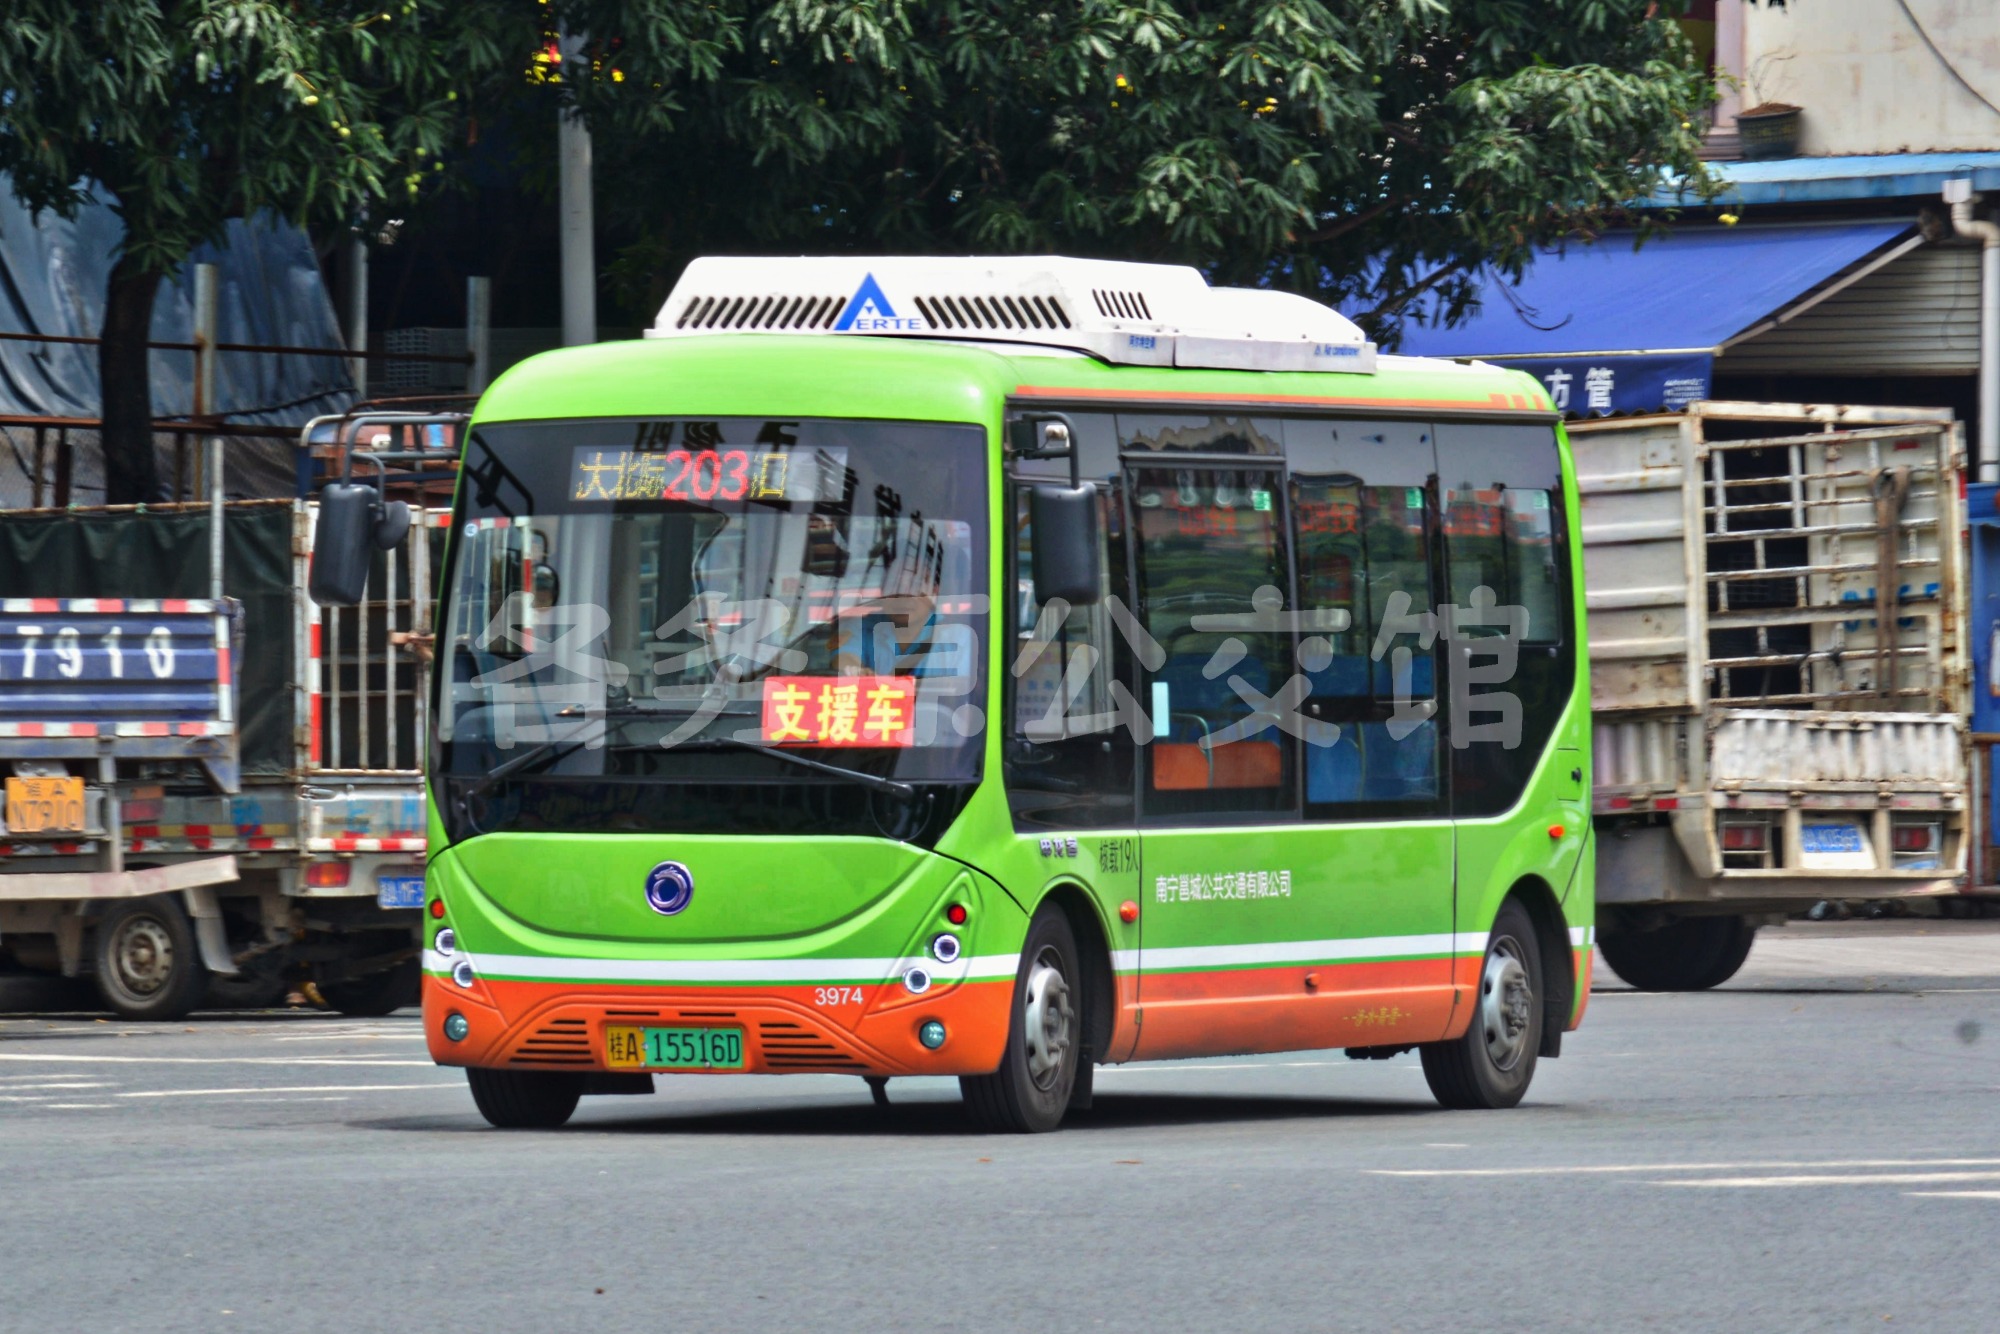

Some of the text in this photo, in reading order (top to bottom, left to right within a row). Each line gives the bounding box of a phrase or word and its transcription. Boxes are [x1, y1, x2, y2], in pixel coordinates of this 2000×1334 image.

[1544, 367, 1615, 408] 方管
[770, 684, 905, 741] 支援车
[814, 987, 864, 1006] 3974
[609, 1032, 741, 1063] 桂A 15516D
